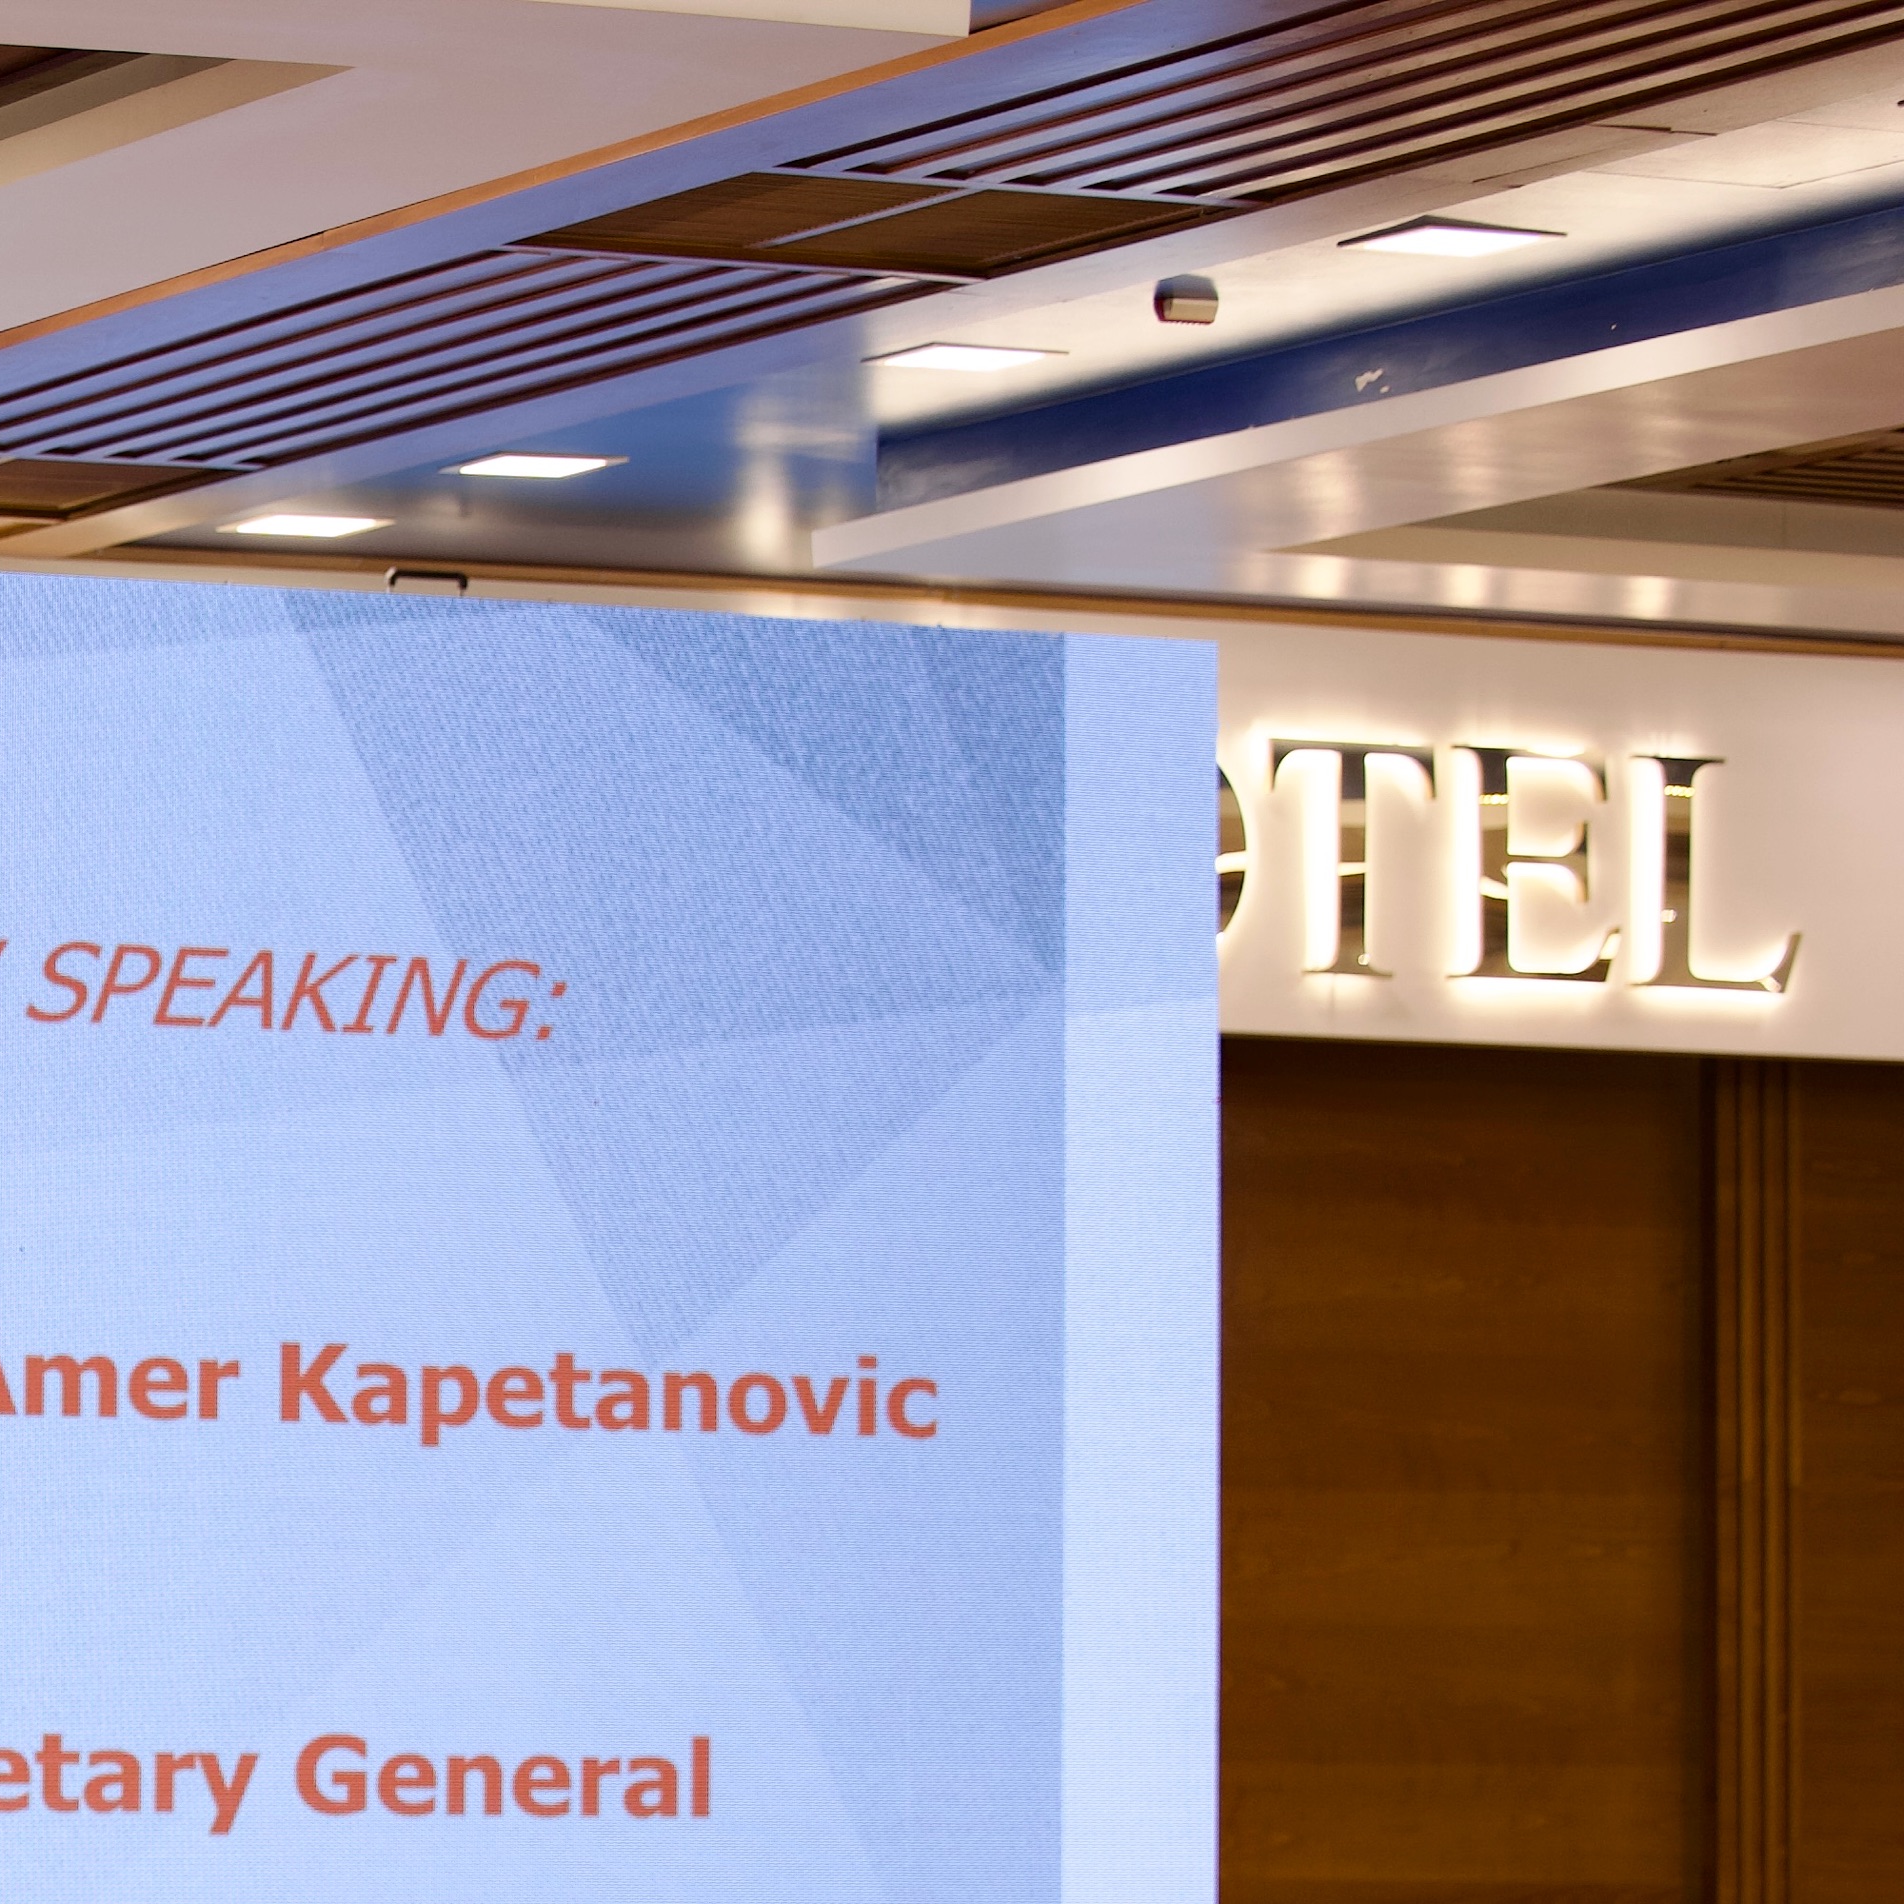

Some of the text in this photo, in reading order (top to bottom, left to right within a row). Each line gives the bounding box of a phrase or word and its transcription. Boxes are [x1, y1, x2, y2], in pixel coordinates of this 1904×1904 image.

[1217, 738, 1803, 993] TEL
[24, 940, 568, 1041] SPEAKING:
[277, 1341, 939, 1448] Kapetanovic
[293, 1733, 713, 1819] General
